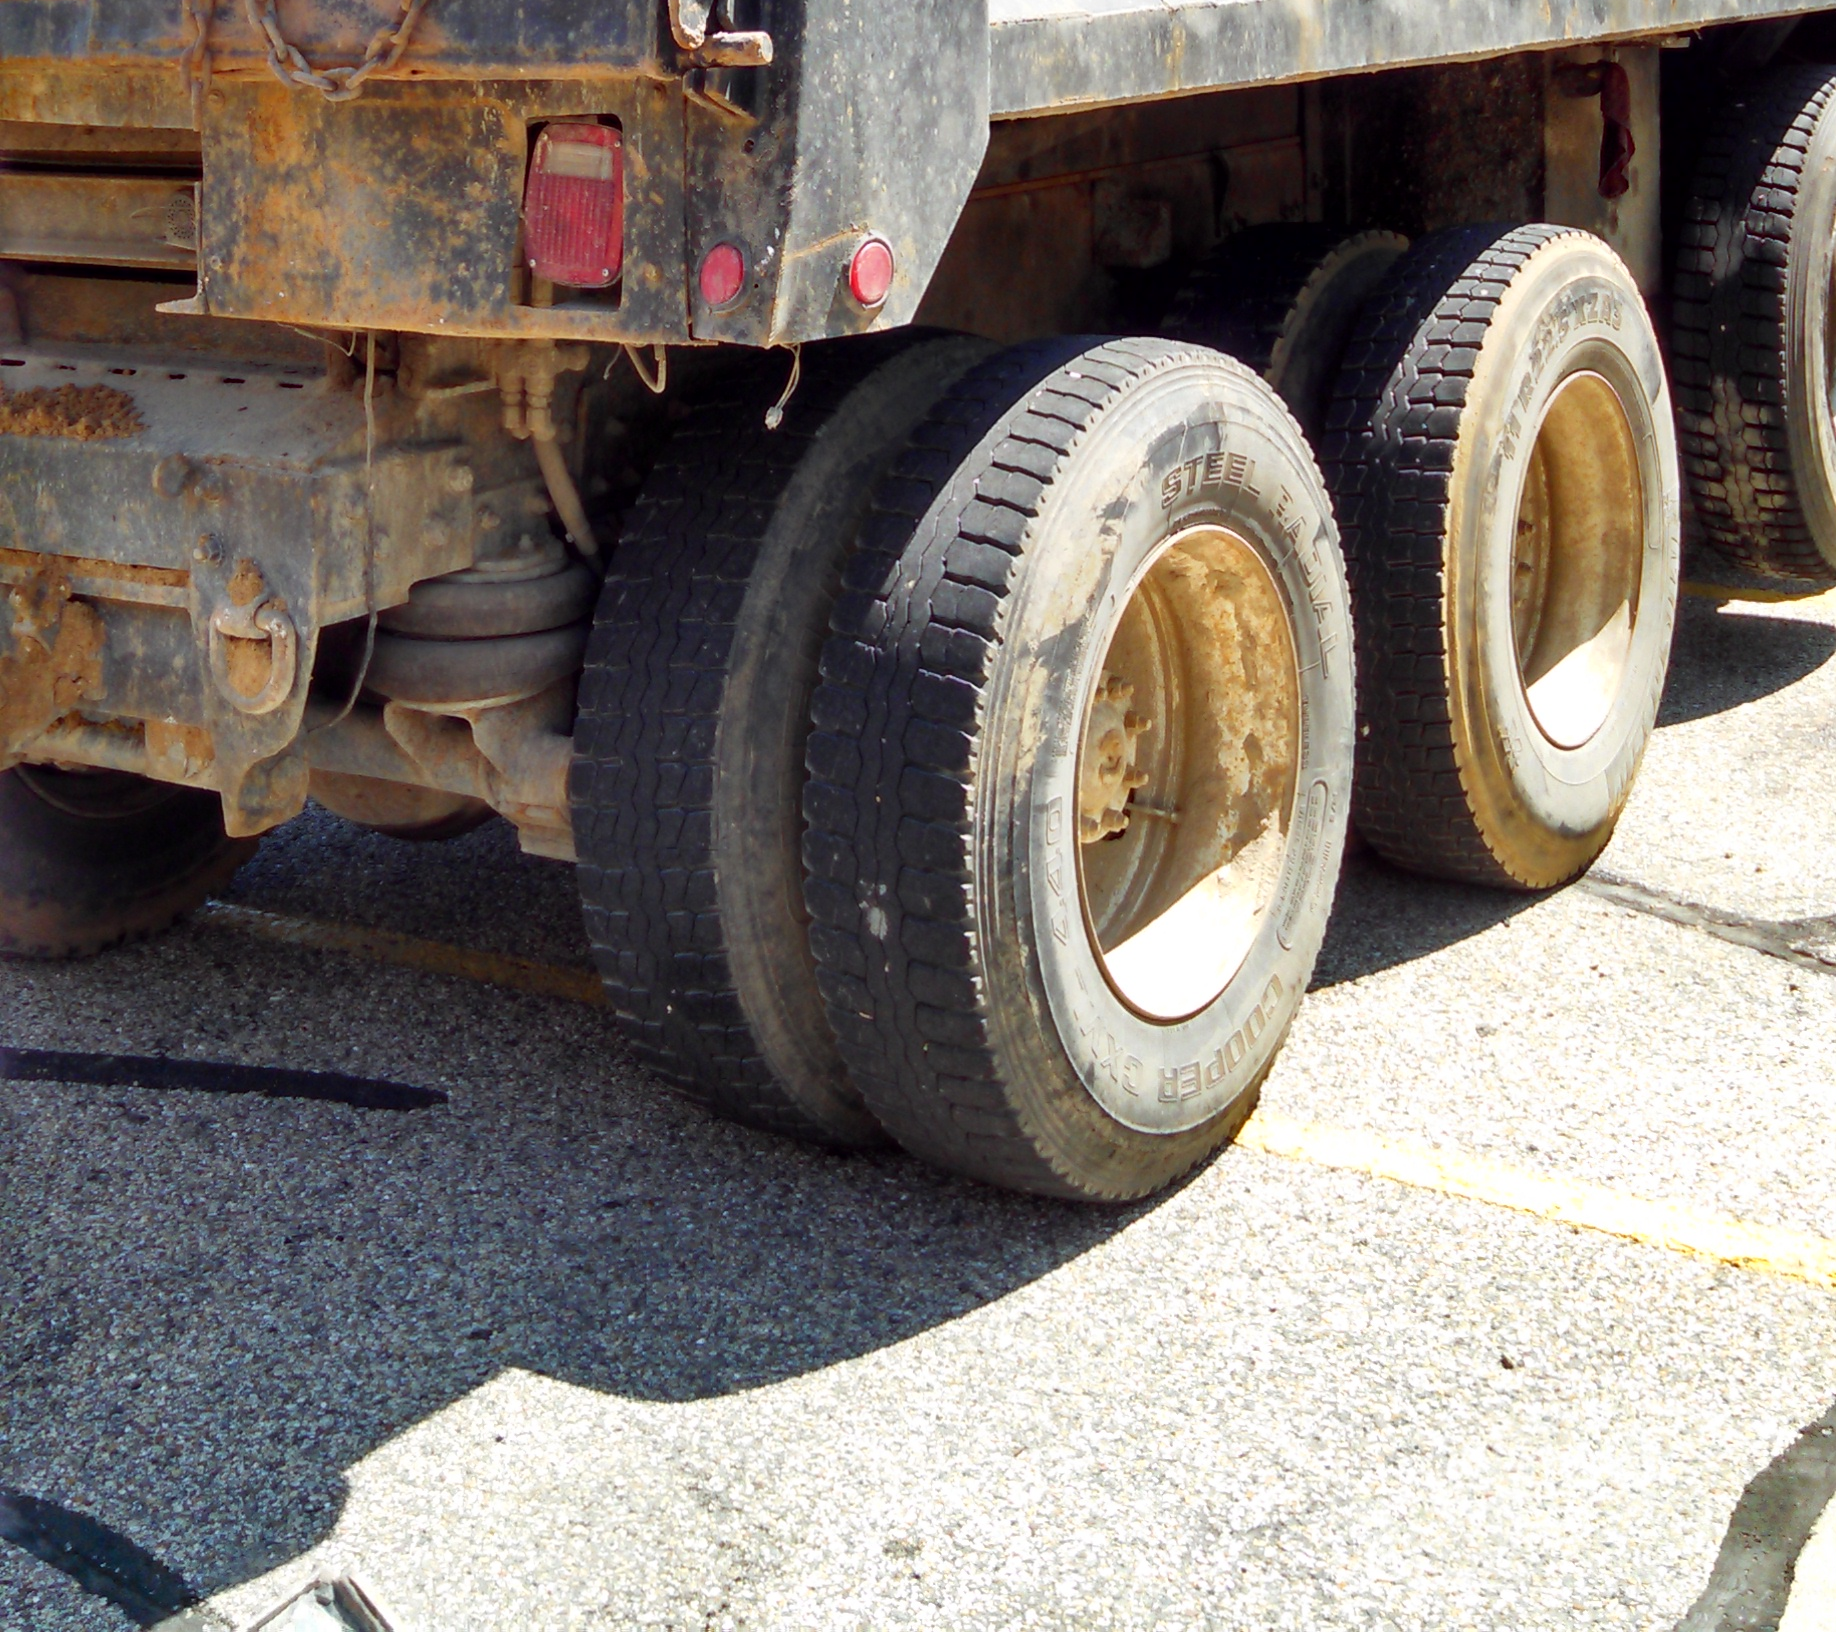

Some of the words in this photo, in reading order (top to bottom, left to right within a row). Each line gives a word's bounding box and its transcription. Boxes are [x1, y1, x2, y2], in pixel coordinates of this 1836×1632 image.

[1161, 450, 1260, 507] STEEL
[1269, 485, 1337, 679] RADIAL
[1158, 973, 1282, 1103] COOPER
